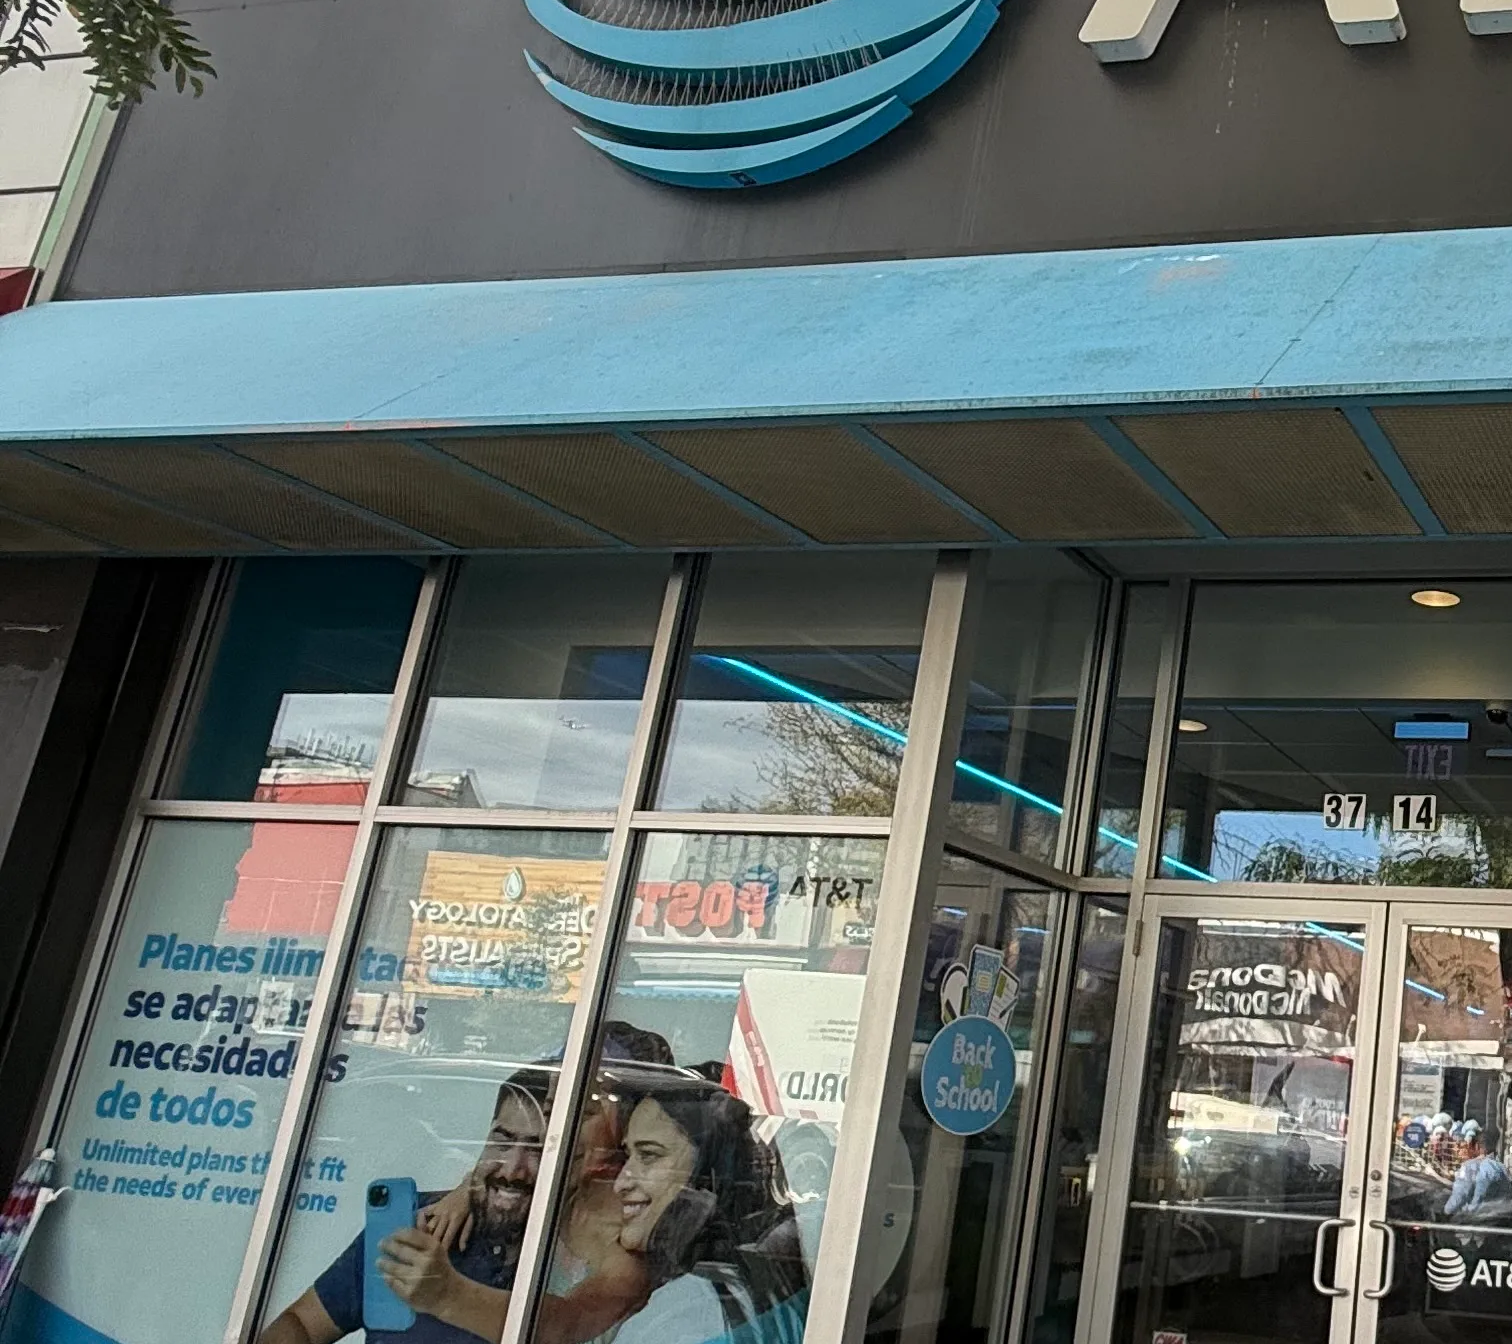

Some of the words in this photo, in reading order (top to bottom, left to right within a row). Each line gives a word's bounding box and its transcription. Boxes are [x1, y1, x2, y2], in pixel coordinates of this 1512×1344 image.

[1325, 795, 1364, 828] 37
[1398, 797, 1433, 830] 14
[784, 875, 874, 910] AT&T
[138, 932, 256, 975] Planes
[123, 988, 165, 1019] se
[109, 1034, 349, 1083] necesidads
[951, 1032, 996, 1070] Back
[95, 1079, 142, 1121] de
[149, 1086, 257, 1129] todos
[934, 1075, 1001, 1114] School
[82, 1137, 184, 1169] Unlimited
[186, 1146, 248, 1175] plans
[251, 1151, 316, 1178] tht
[319, 1157, 346, 1183] fit
[73, 1167, 109, 1192] the
[111, 1174, 178, 1201] needs
[181, 1177, 210, 1202] of
[211, 1183, 338, 1213] everone
